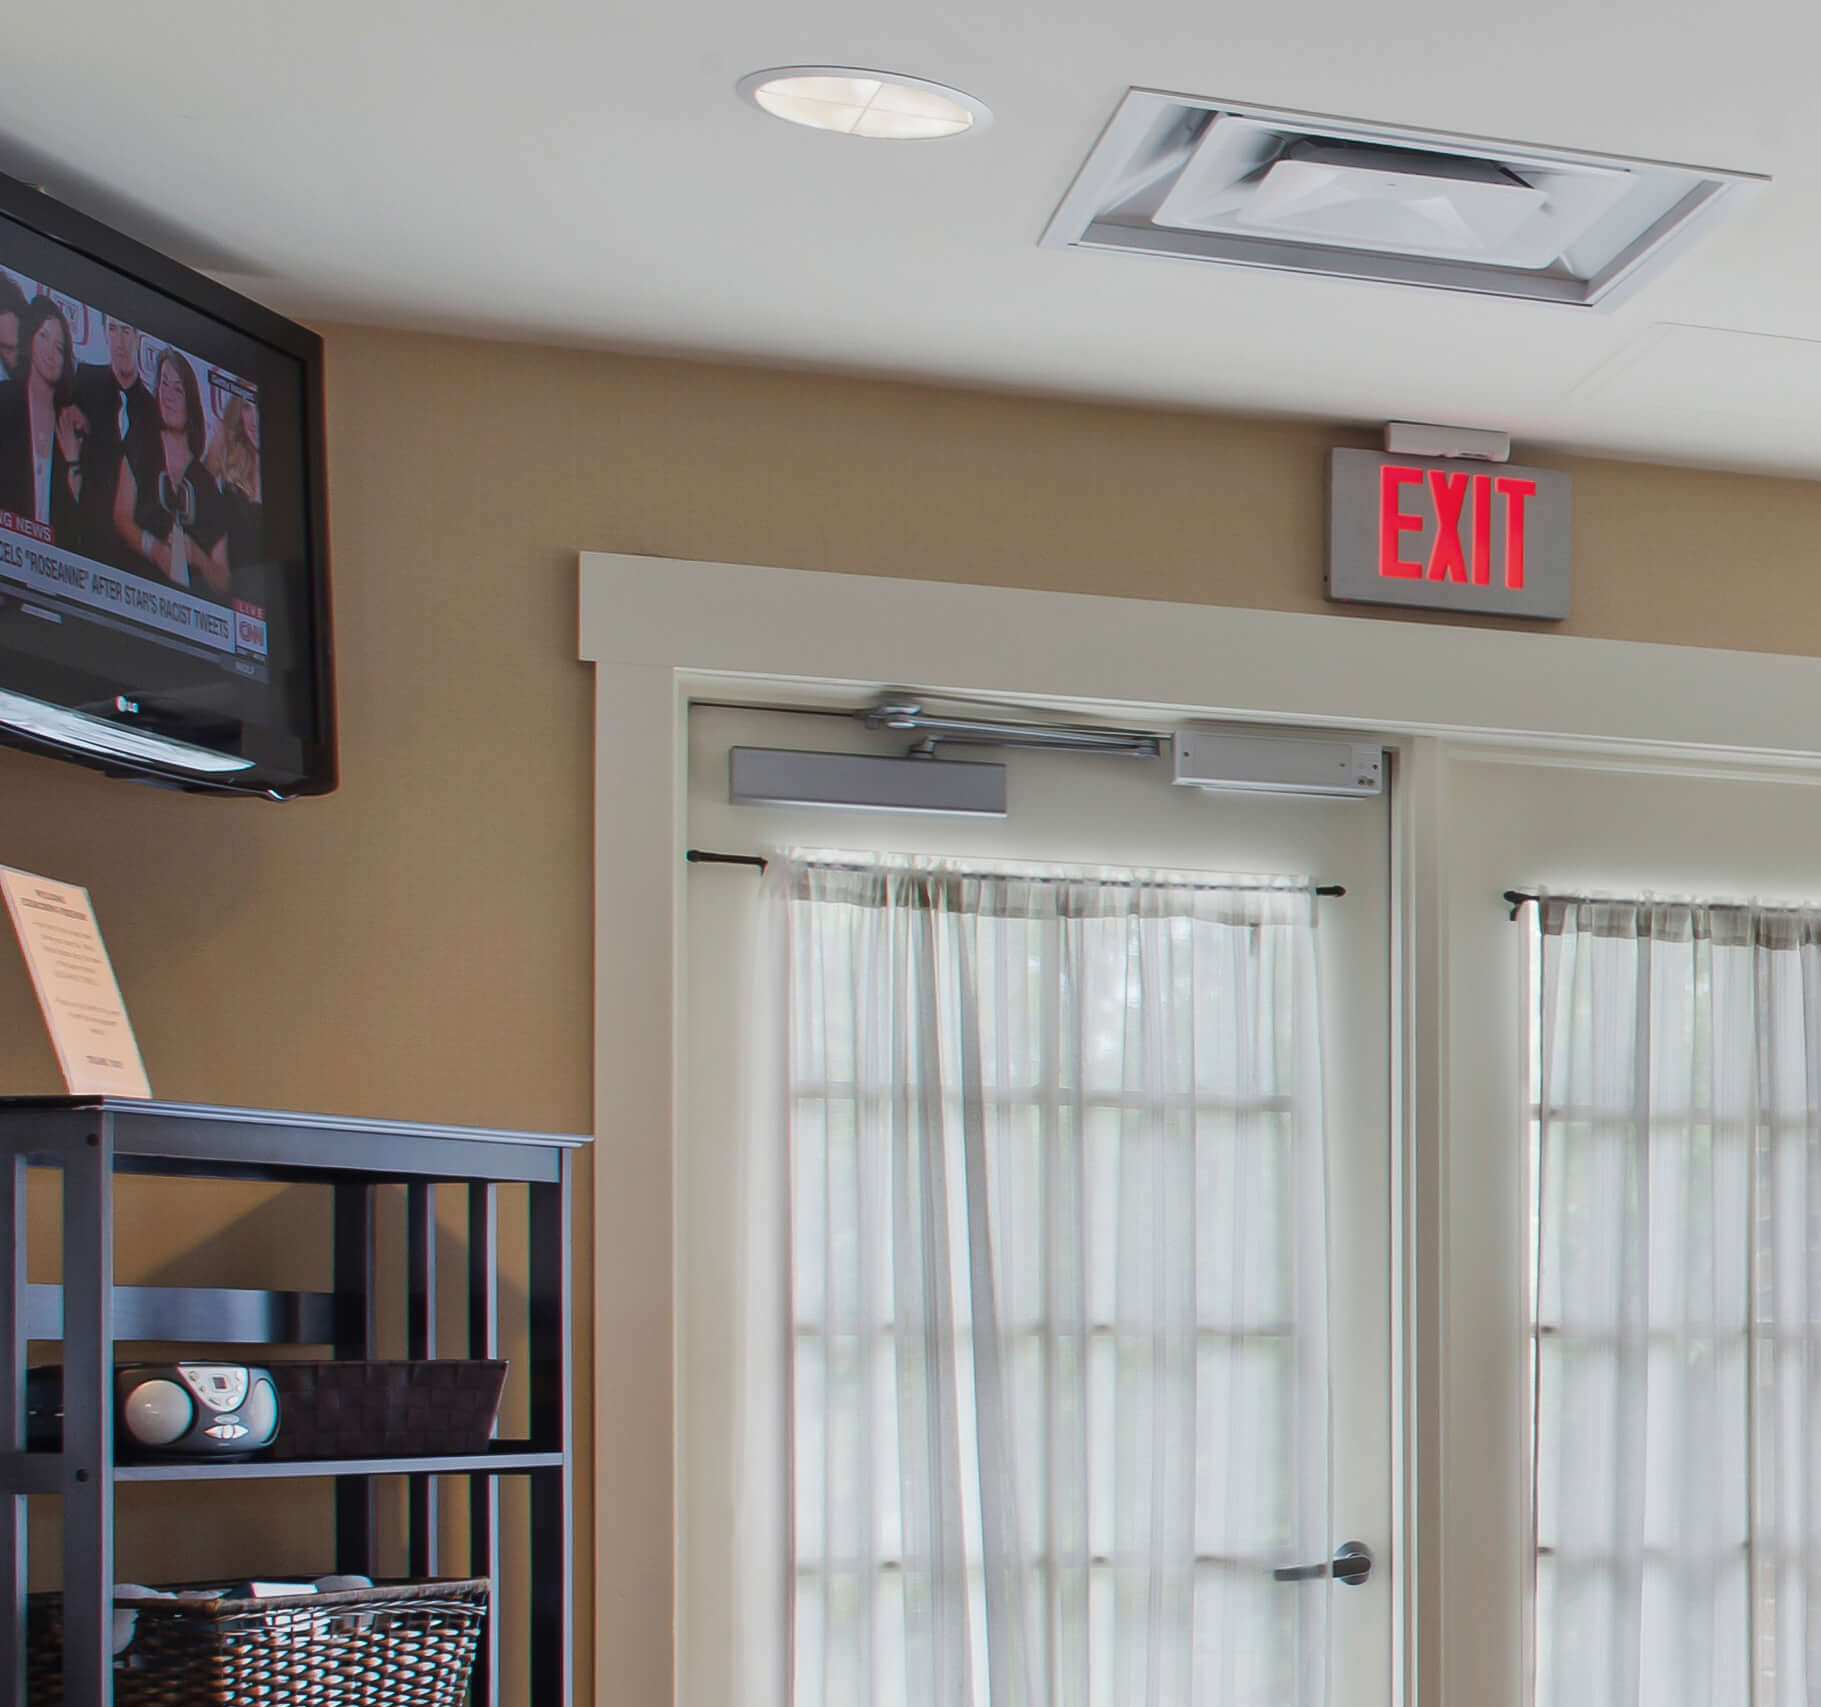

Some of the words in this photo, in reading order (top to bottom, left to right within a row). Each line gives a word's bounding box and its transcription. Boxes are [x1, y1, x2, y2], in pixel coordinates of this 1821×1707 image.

[16, 516, 51, 541] NEWS
[1379, 464, 1536, 590] EXIT
[92, 573, 122, 601] AFTER
[160, 597, 193, 625] RACIST
[194, 608, 229, 640] TWEETS
